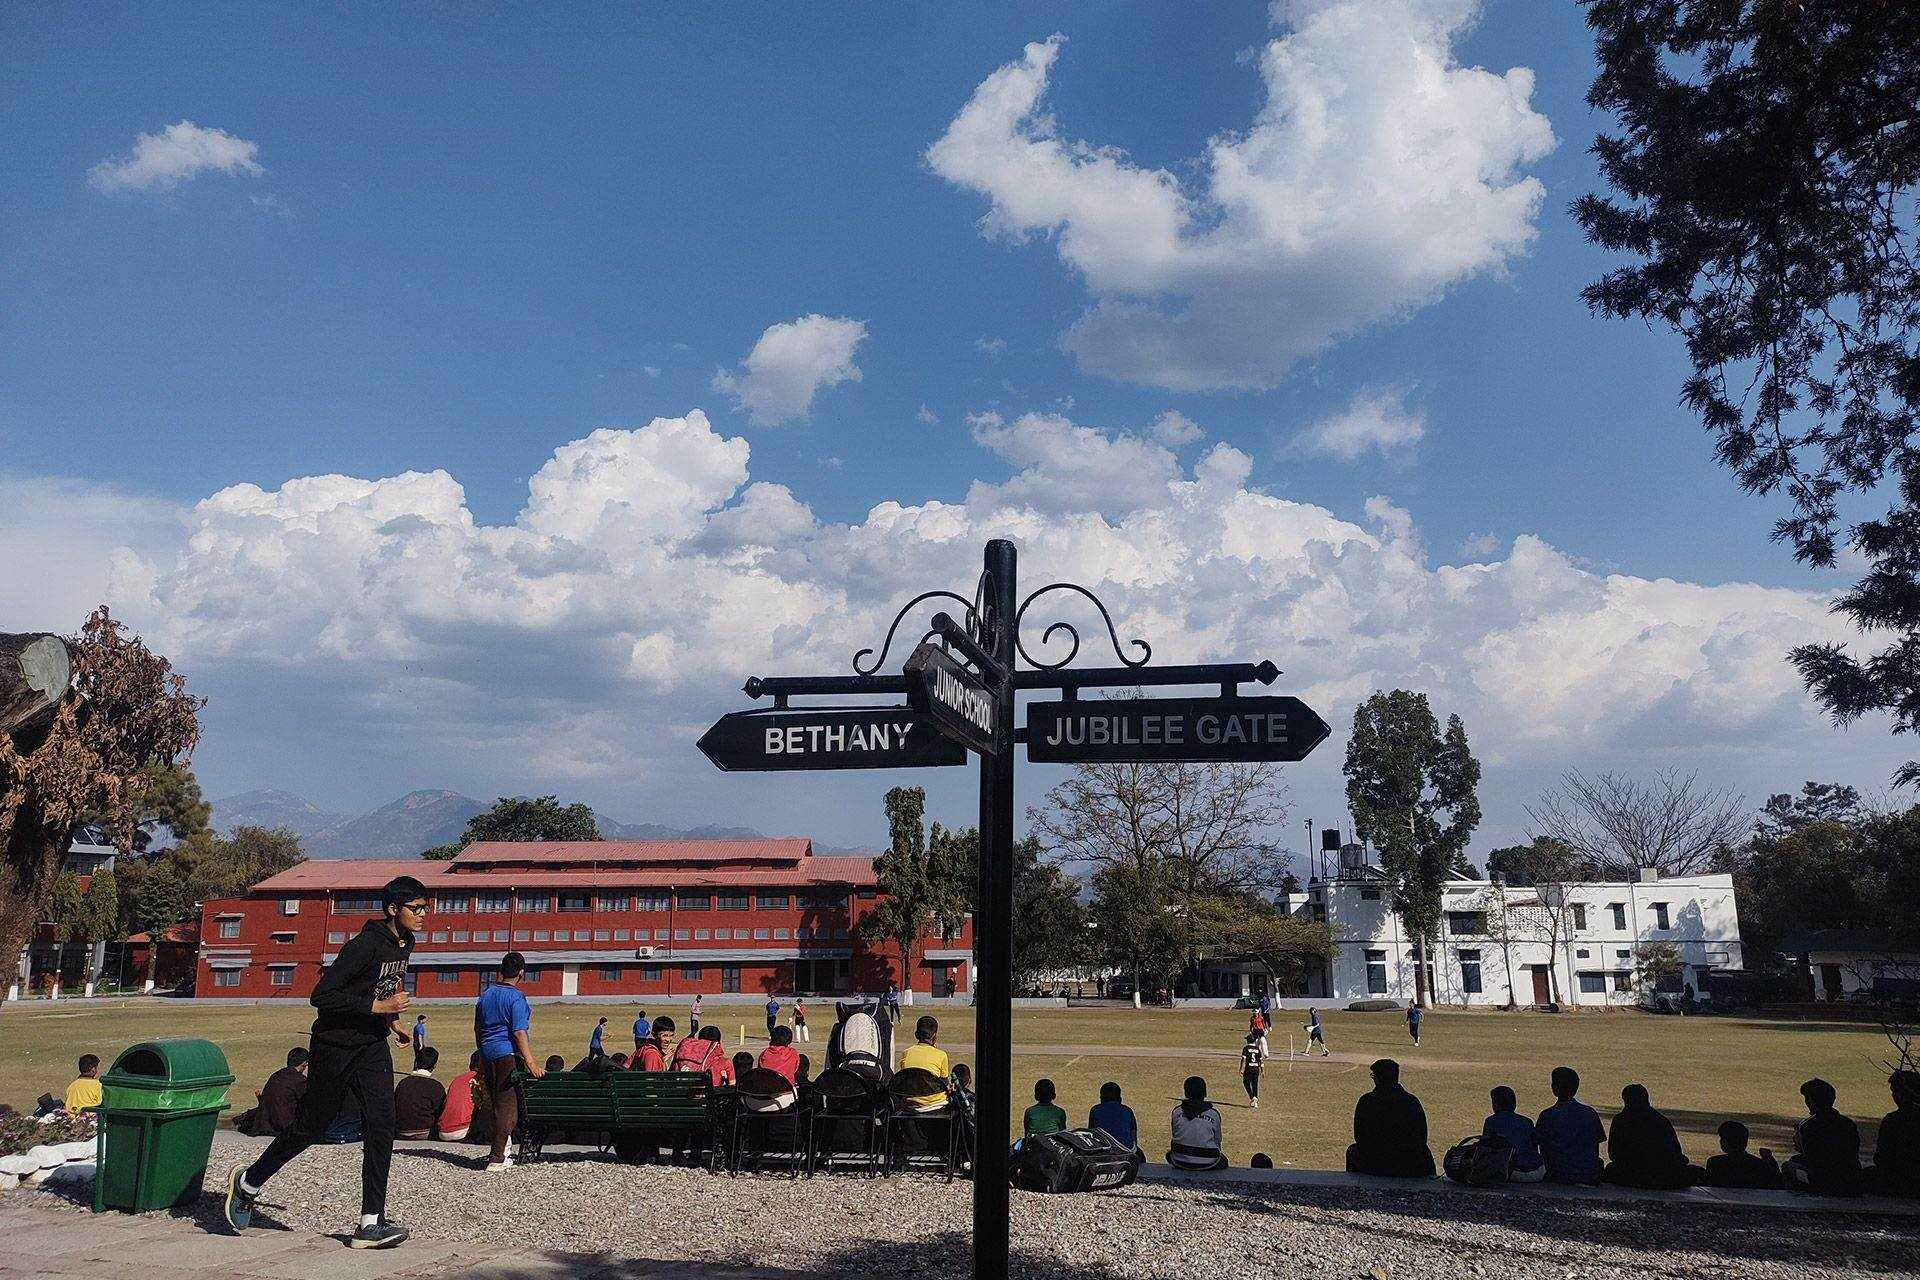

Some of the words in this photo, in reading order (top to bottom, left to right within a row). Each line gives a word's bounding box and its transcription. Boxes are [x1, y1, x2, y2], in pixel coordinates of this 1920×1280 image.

[933, 665, 964, 715] JUNIOR
[964, 688, 992, 734] SCHOOL
[765, 722, 914, 754] BETHANY
[1046, 715, 1185, 746] JUBILEE
[1196, 713, 1289, 744] GATE
